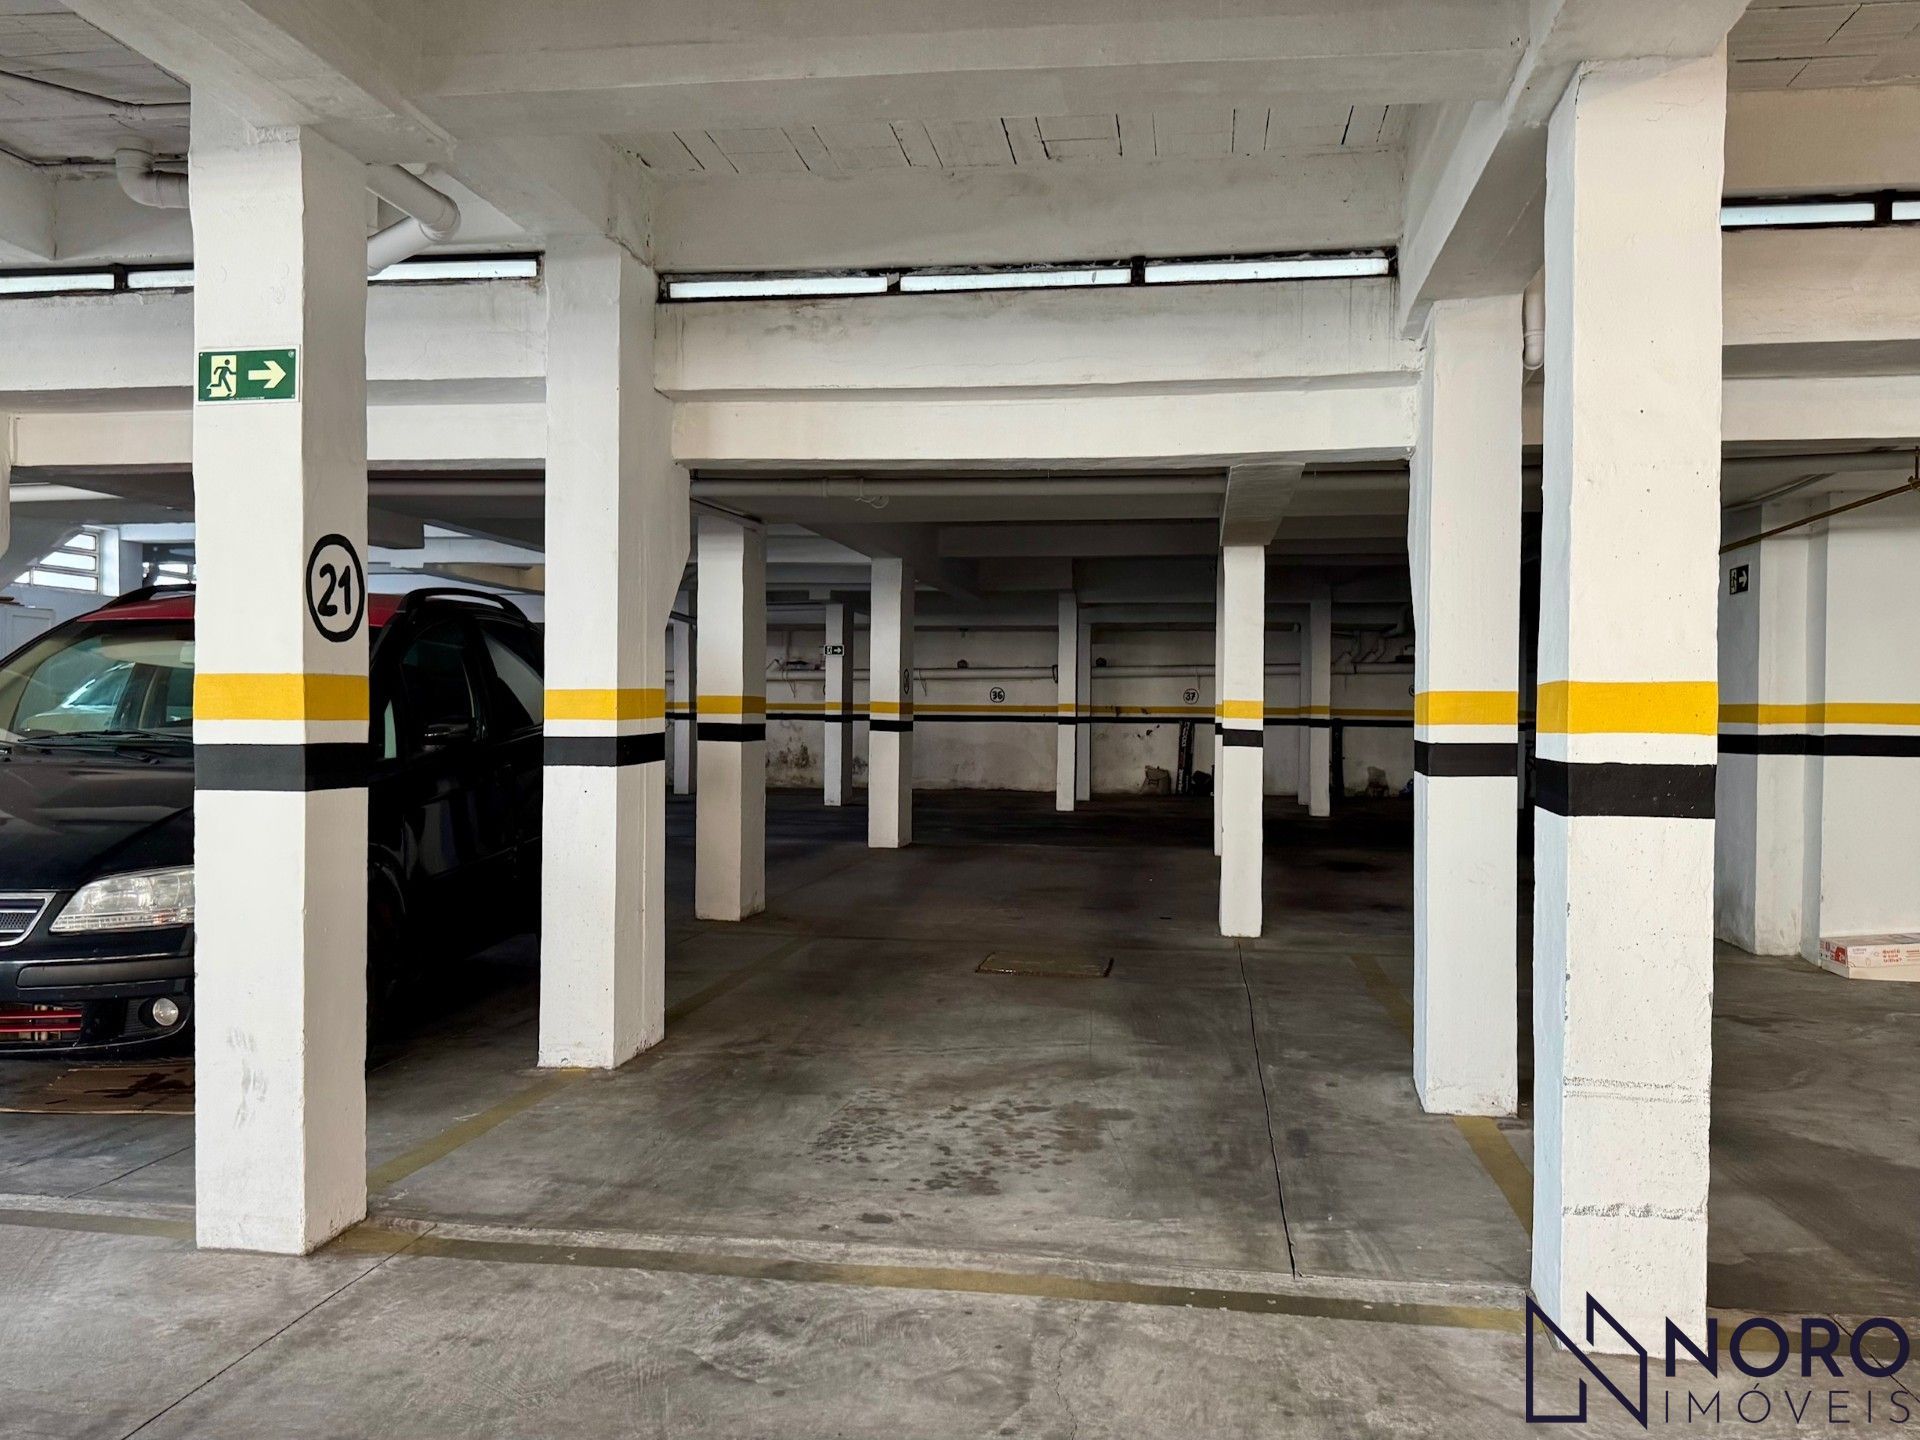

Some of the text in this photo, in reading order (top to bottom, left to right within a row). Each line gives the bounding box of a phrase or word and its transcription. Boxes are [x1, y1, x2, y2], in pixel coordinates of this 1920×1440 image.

[317, 563, 351, 617] 21
[992, 690, 1003, 700] 36
[1185, 691, 1196, 701] 37
